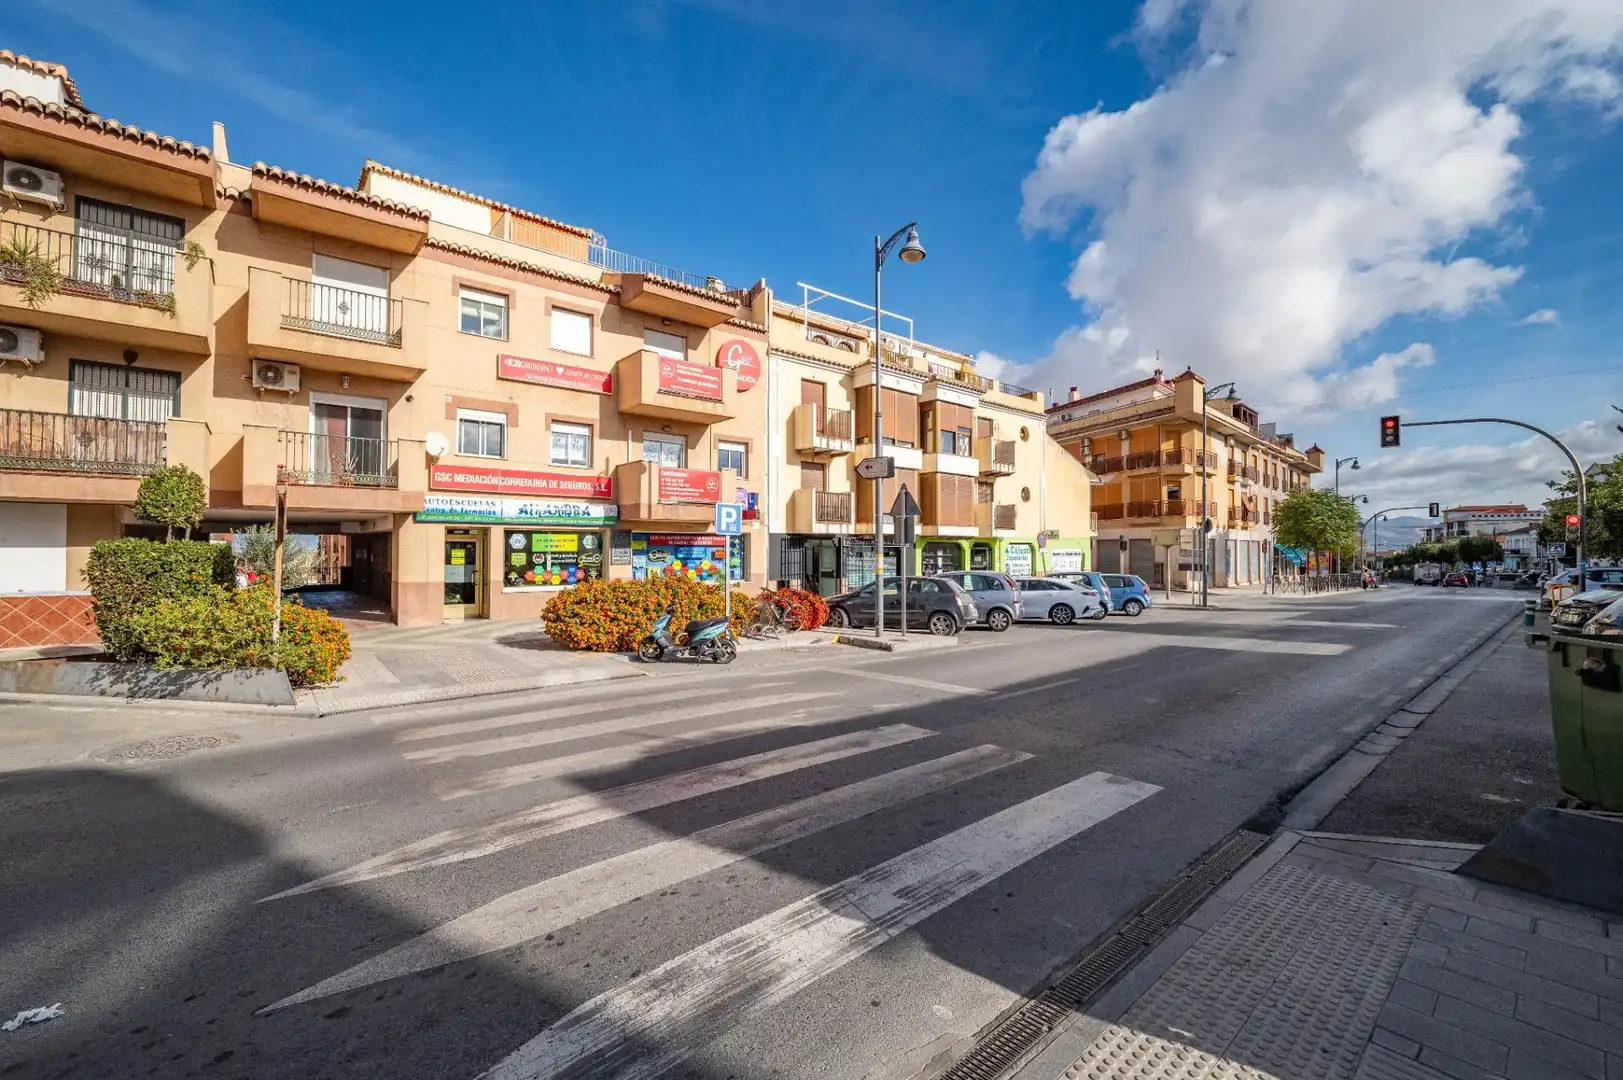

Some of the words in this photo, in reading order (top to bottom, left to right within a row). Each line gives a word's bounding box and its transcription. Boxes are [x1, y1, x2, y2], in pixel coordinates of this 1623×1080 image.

[435, 472, 453, 482] GSC
[454, 473, 499, 485] MEDIACIÓN
[500, 476, 547, 488] CORREDURÍA
[549, 480, 558, 489] DE
[721, 506, 737, 531] P
